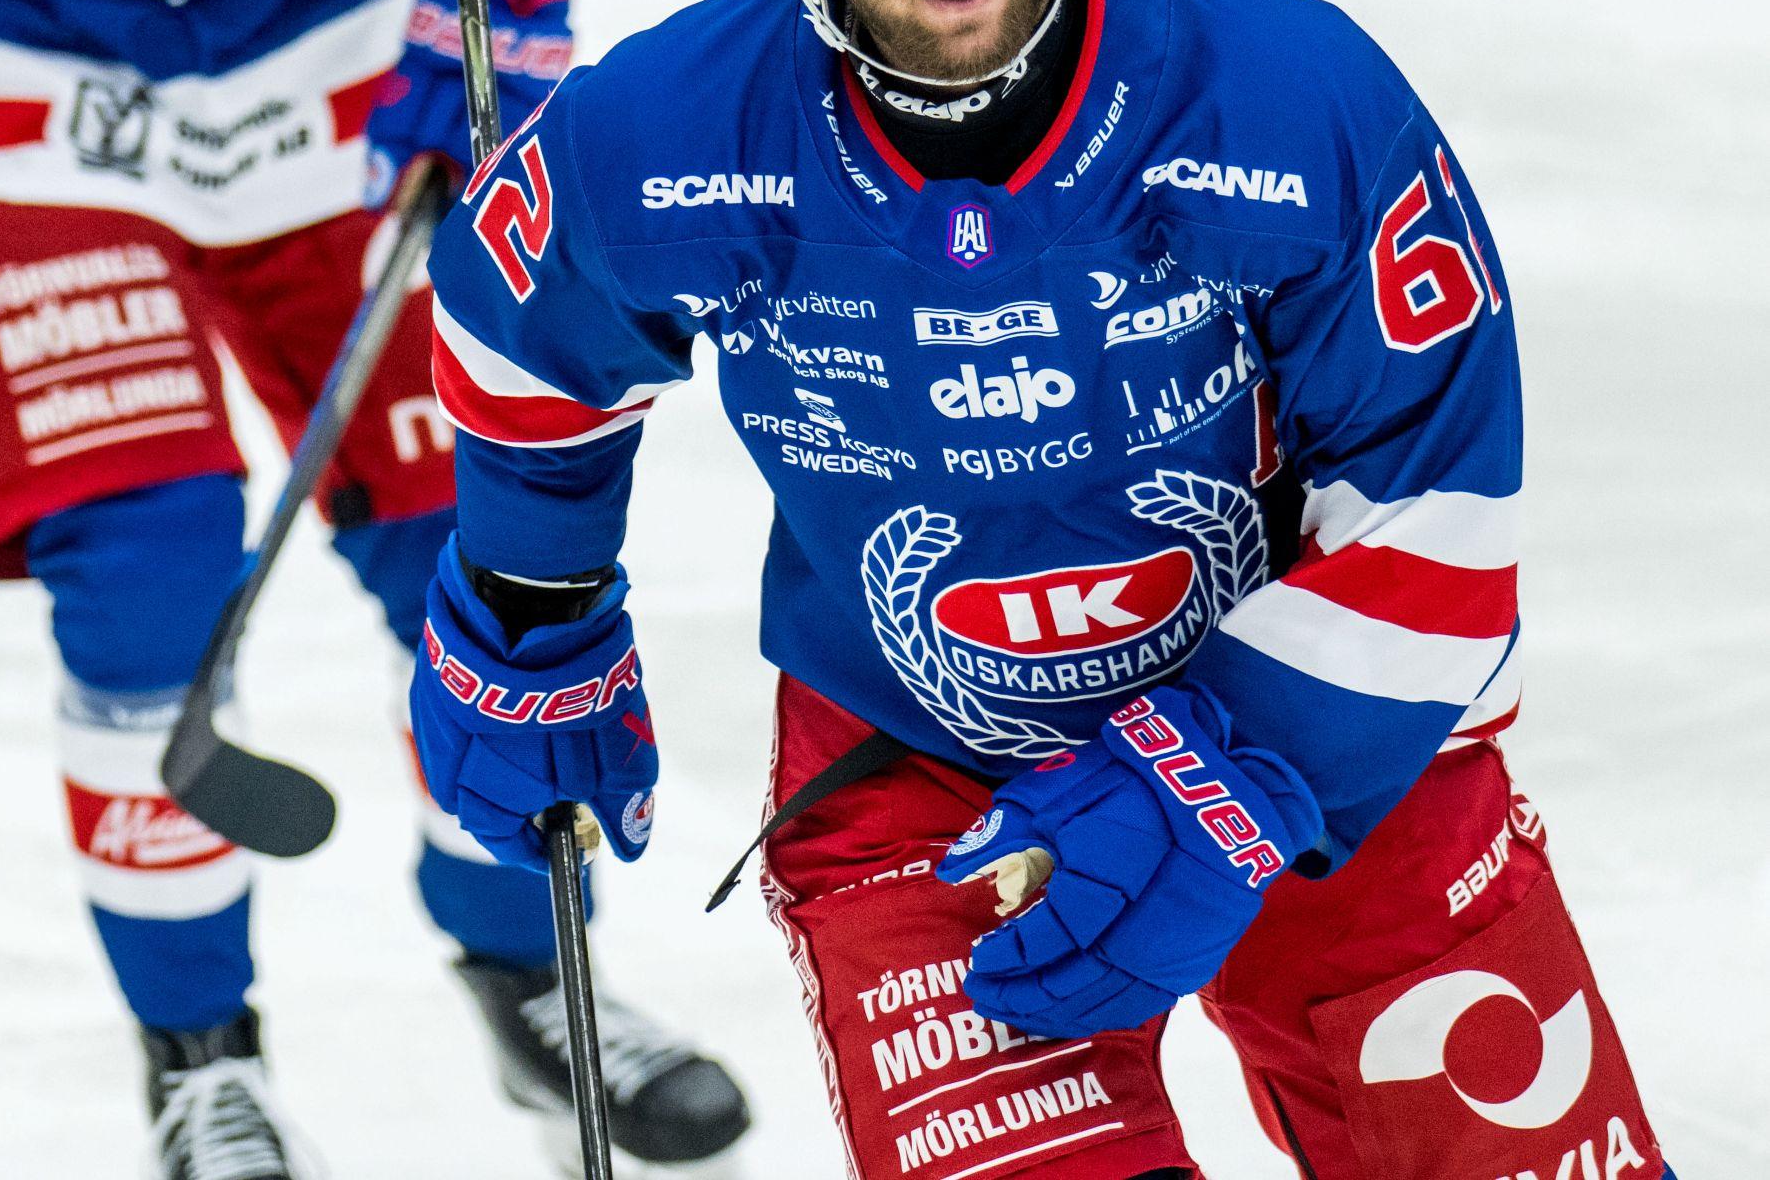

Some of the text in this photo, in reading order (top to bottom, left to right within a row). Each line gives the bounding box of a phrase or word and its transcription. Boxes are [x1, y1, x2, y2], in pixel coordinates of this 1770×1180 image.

[884, 90, 991, 122] elajo
[1075, 81, 1130, 176] BAUER
[641, 173, 795, 209] SCANIA
[1142, 157, 1309, 208] SCANIA
[1369, 144, 1502, 354] 6
[1166, 316, 1211, 344] Systems
[824, 368, 867, 382] Skog
[870, 374, 890, 388] AB
[930, 356, 1076, 423] elajo
[742, 413, 917, 470] PRESS KOGYO
[782, 444, 893, 481] SWEDEN
[998, 574, 1146, 643] IK
[952, 595, 1201, 693] OSKARSHAMN
[857, 956, 974, 1023] TÖRNV
[871, 1007, 1048, 1091] MÖBL
[896, 1072, 1112, 1174] MÖRLUNDA
